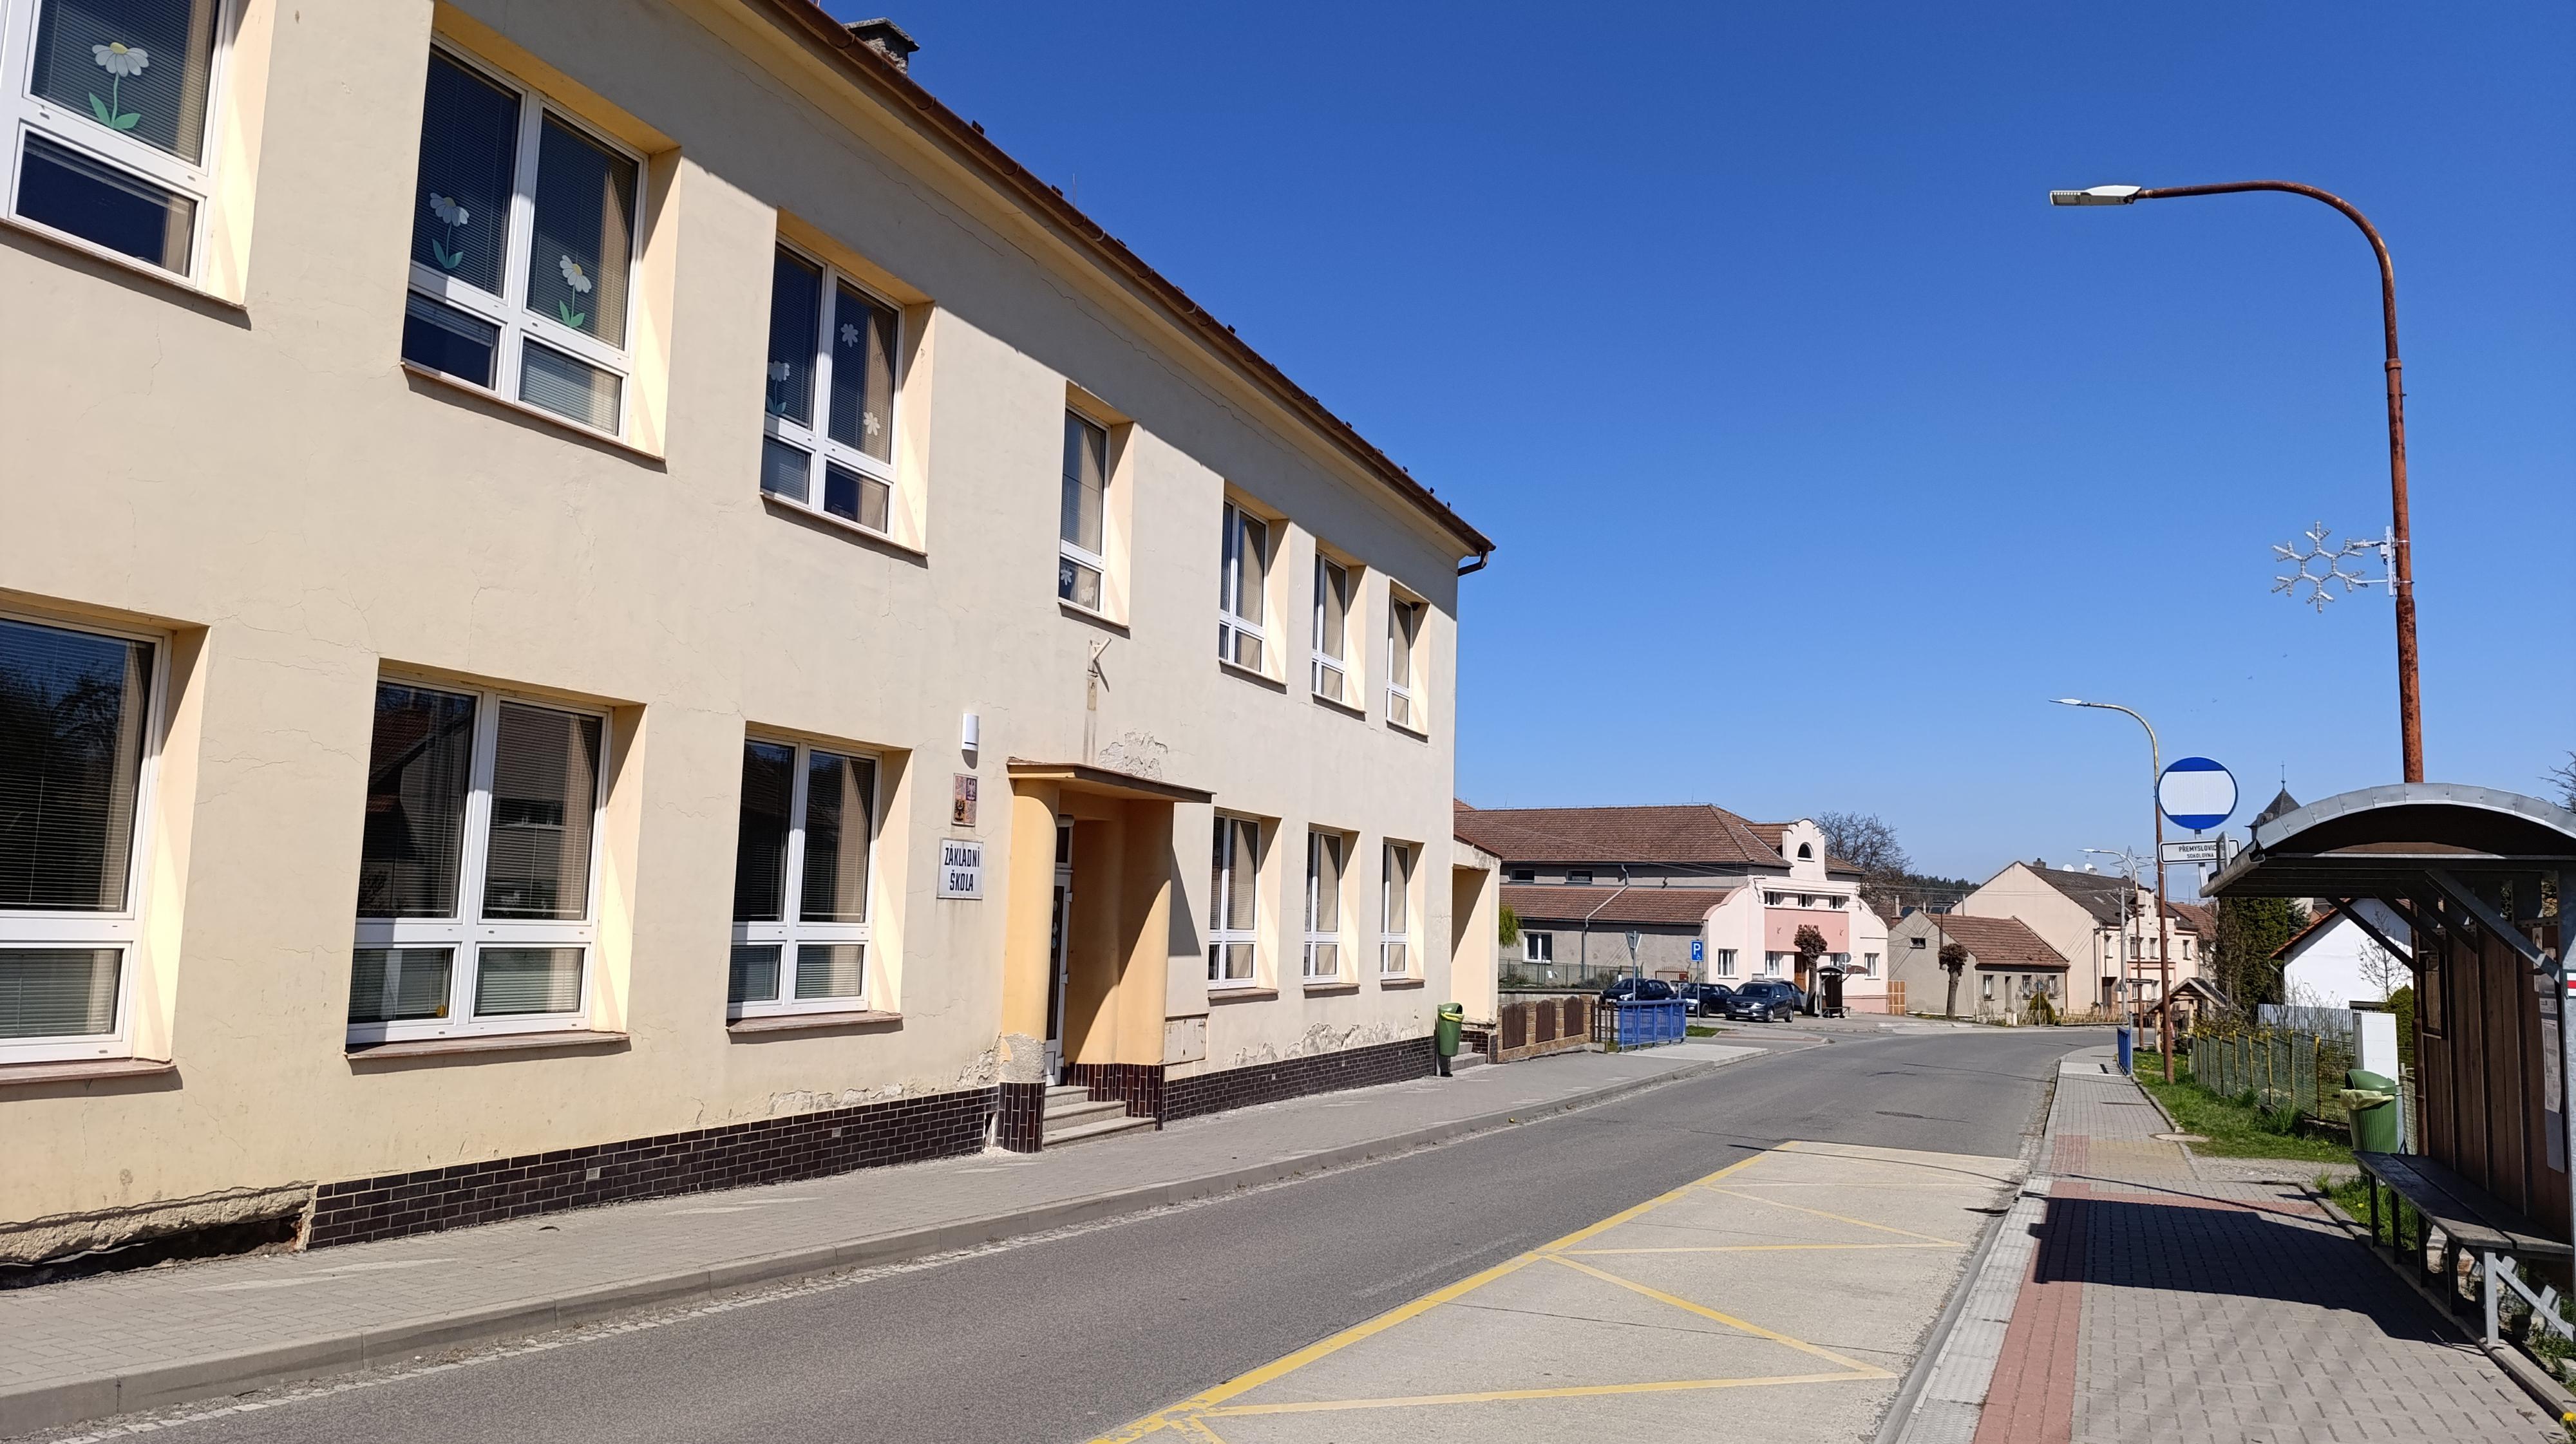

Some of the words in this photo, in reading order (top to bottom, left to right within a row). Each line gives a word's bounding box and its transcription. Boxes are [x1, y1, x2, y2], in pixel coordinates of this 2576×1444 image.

[944, 843, 980, 868] ZÁKLADNÍ
[949, 869, 974, 892] ŠKOLA
[1693, 942, 1701, 955] P
